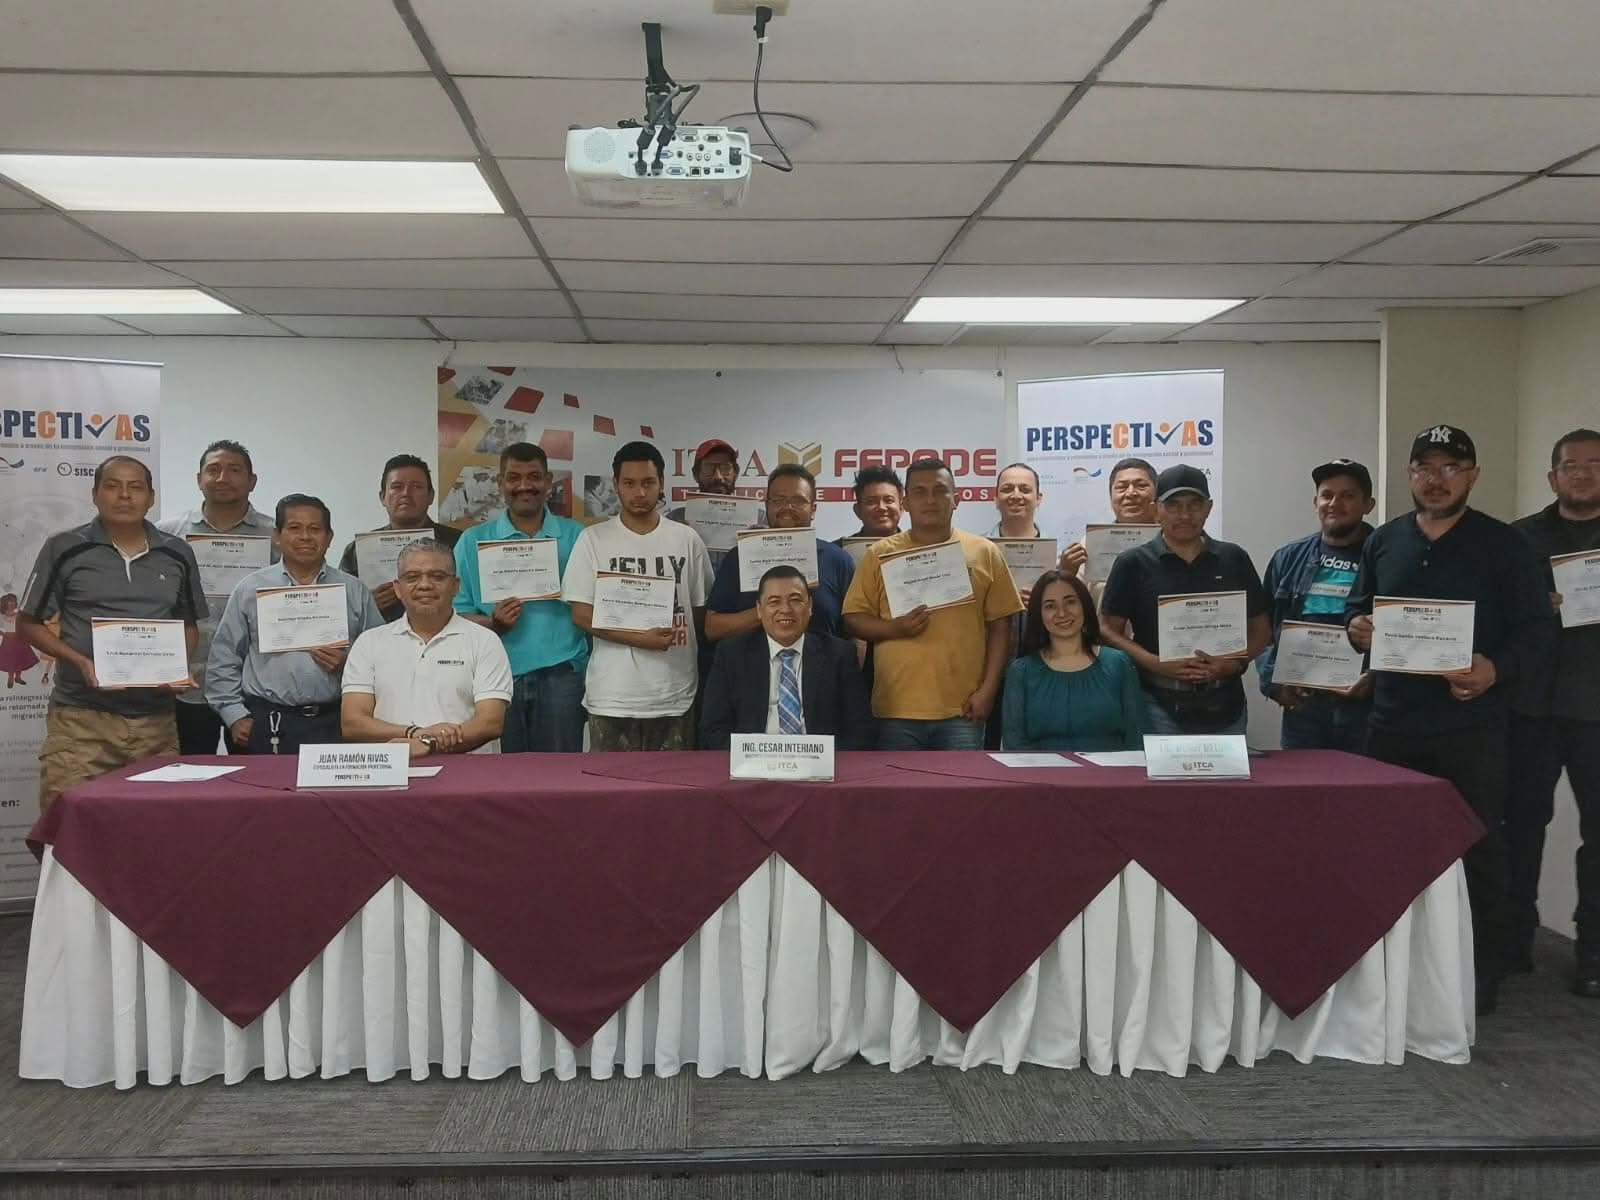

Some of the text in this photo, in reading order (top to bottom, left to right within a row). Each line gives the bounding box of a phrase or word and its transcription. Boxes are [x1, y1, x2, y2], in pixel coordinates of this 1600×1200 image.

[0, 410, 151, 442] PECTIVAS
[1027, 420, 1213, 451] PERSPECTIVAS
[672, 448, 769, 477] IA
[74, 467, 94, 477] SISC
[1320, 553, 1352, 570] idas
[758, 743, 783, 753] CESAR
[785, 743, 824, 753] INTERIANO
[319, 751, 389, 763] JUAN RAMÓN RIVAS
[1193, 761, 1214, 769] ITCA
